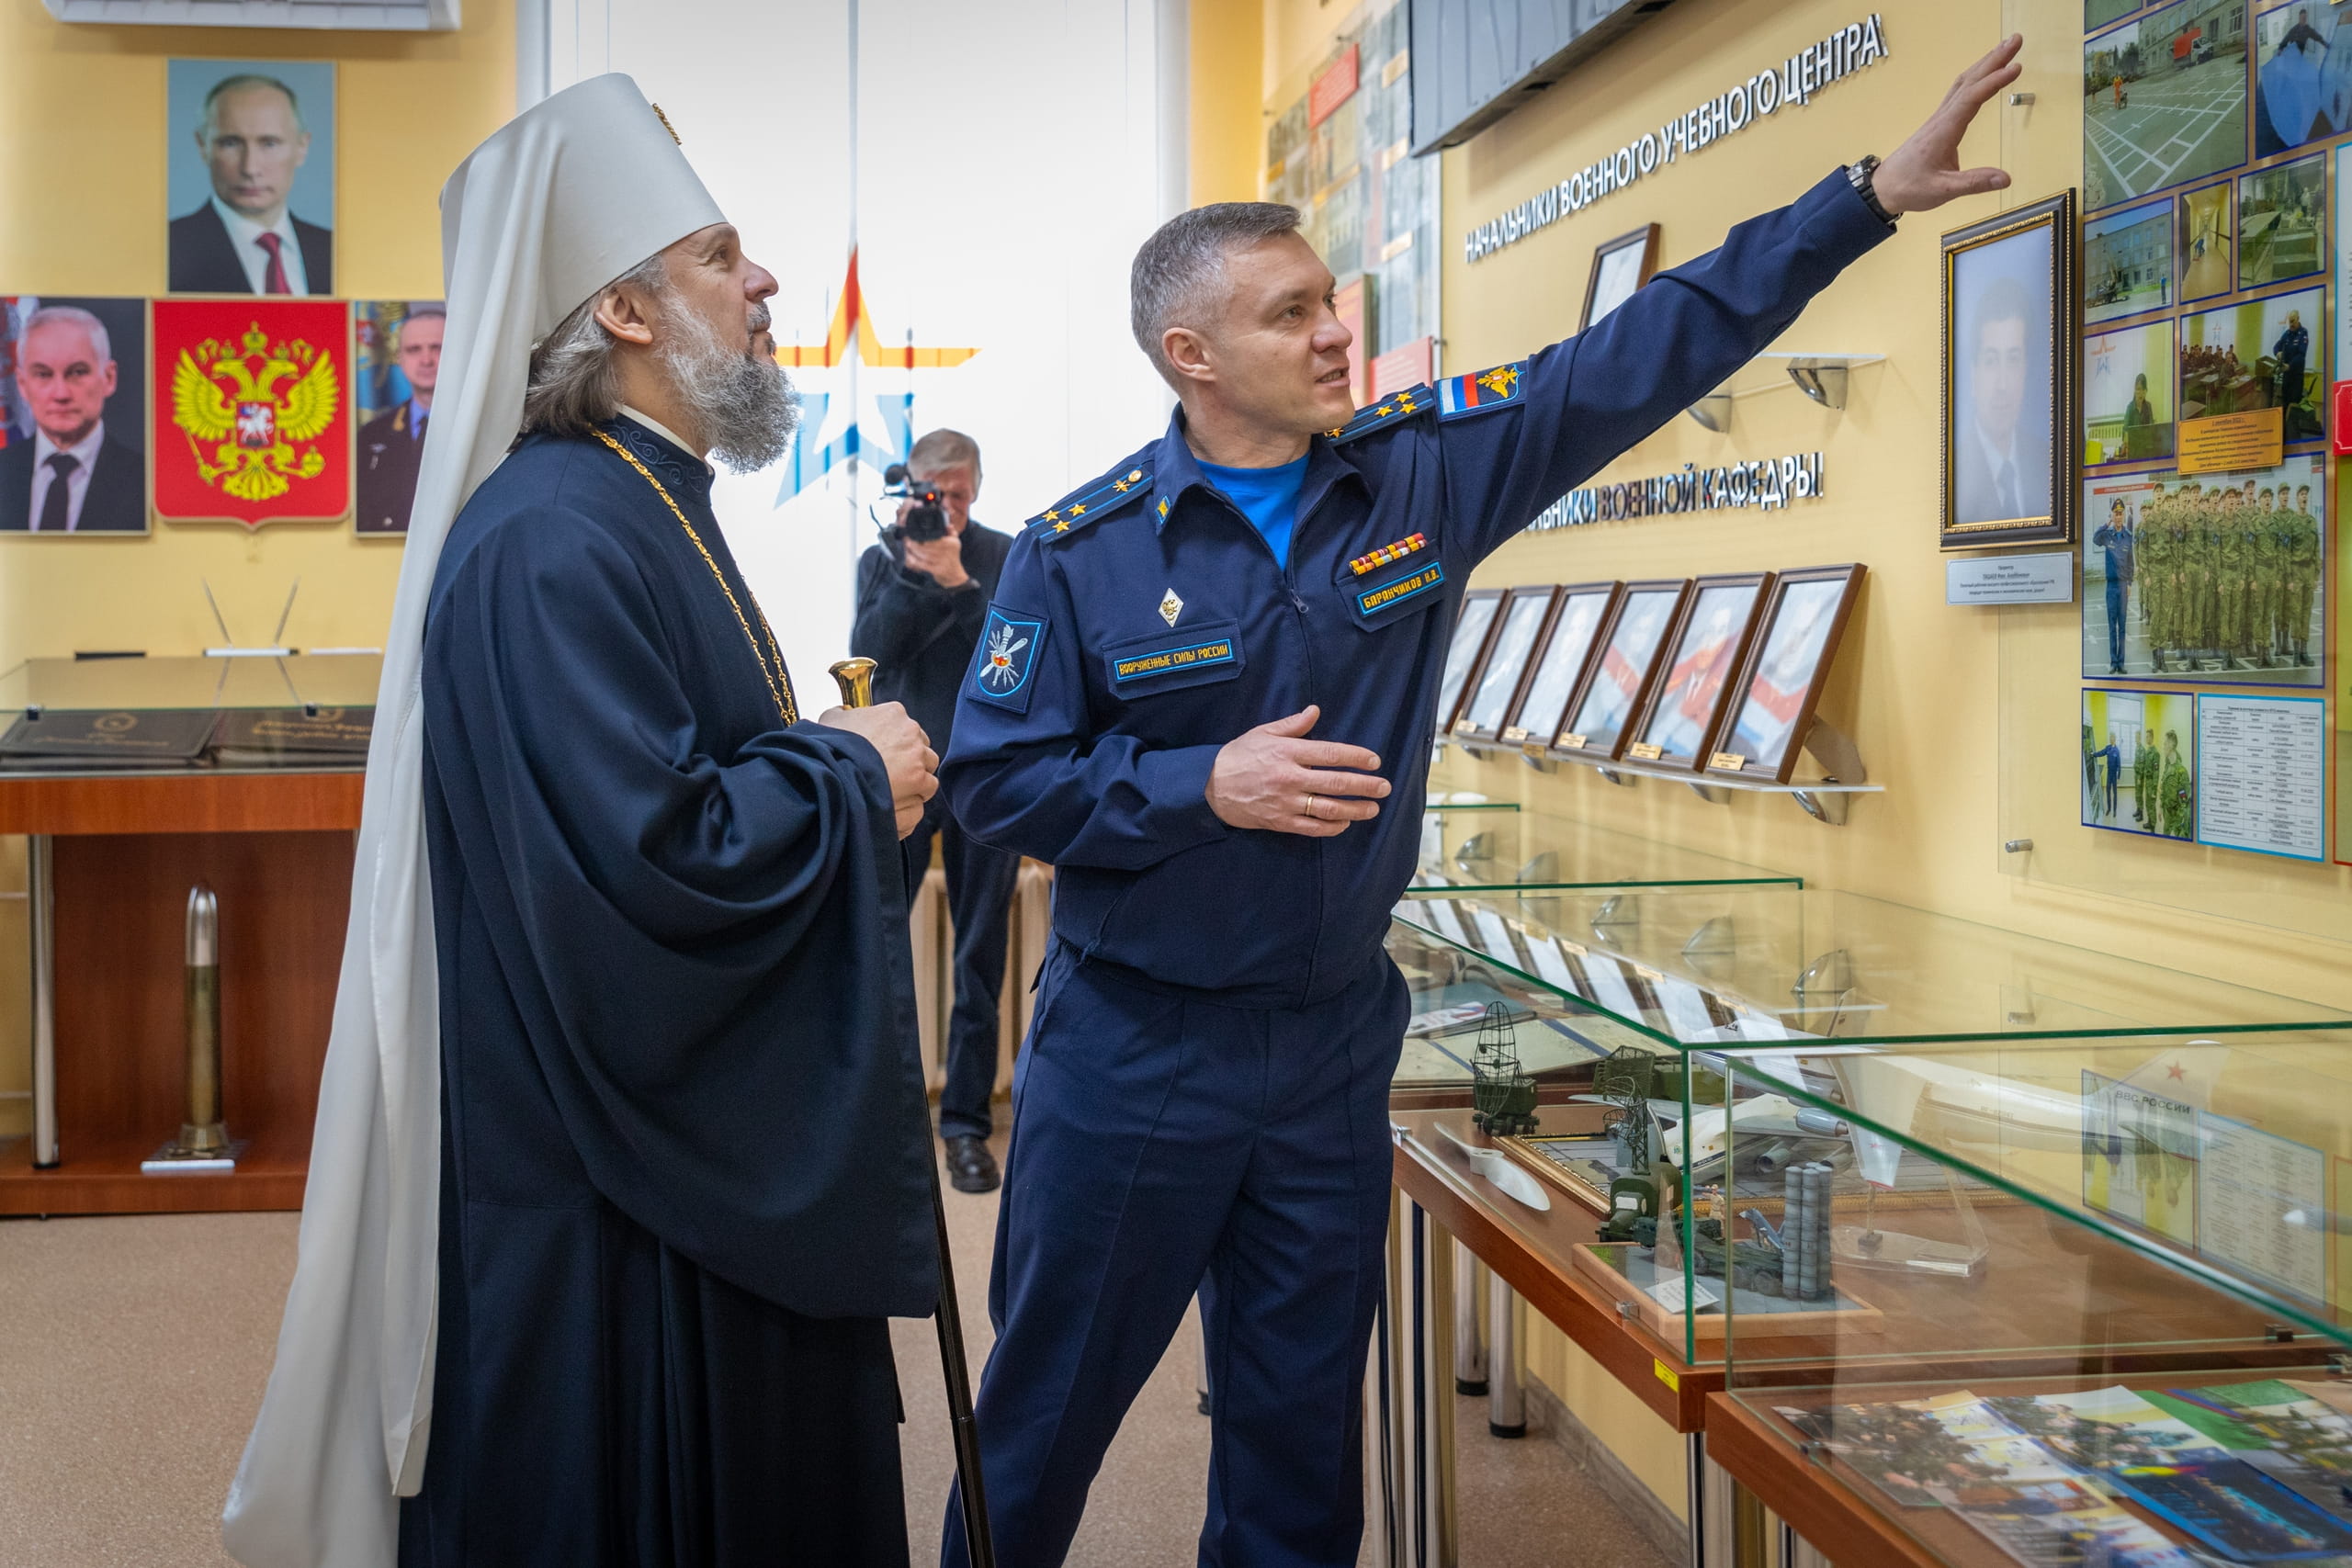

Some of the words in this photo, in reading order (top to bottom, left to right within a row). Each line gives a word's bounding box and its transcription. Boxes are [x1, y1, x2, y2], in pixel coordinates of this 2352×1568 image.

[1464, 185, 1558, 264] НАЧАЛЬНИКИ
[1560, 132, 1658, 218] ВОЕННОГО
[1660, 69, 1781, 163] УЧЕБНОГО
[1783, 14, 1888, 105] ЦЕНТРА
[1600, 463, 1696, 520] ВОЕННОЙ
[1701, 452, 1824, 511] КАФЕДРЫ
[1363, 577, 1422, 608] БАРАНЧИКОВ
[1119, 655, 1170, 675] ВООРУЖЕННЫЕ
[1173, 650, 1195, 663] СИЛЫ
[1198, 645, 1227, 659] РОССИИ
[2116, 1090, 2138, 1102] ВВС
[2143, 1096, 2190, 1114] РОССИИ
